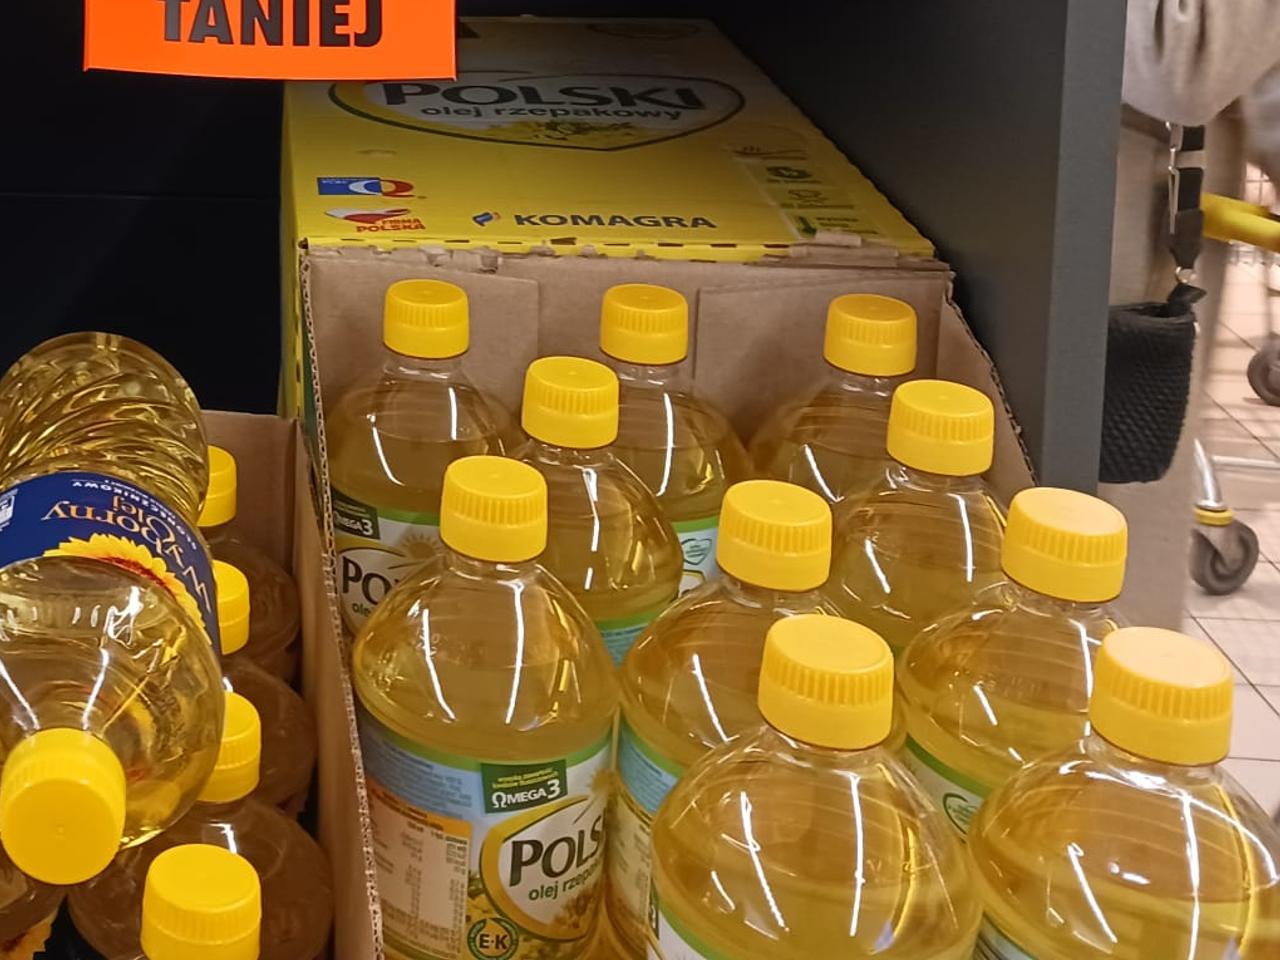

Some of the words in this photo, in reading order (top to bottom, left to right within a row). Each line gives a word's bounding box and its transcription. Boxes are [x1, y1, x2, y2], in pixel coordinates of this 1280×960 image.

[382, 82, 707, 111] POLSKI
[422, 105, 482, 118] olej
[495, 105, 683, 121] rzepakowy
[513, 213, 718, 229] KOMAGRA
[509, 814, 602, 888] POLS
[528, 880, 559, 901] olej
